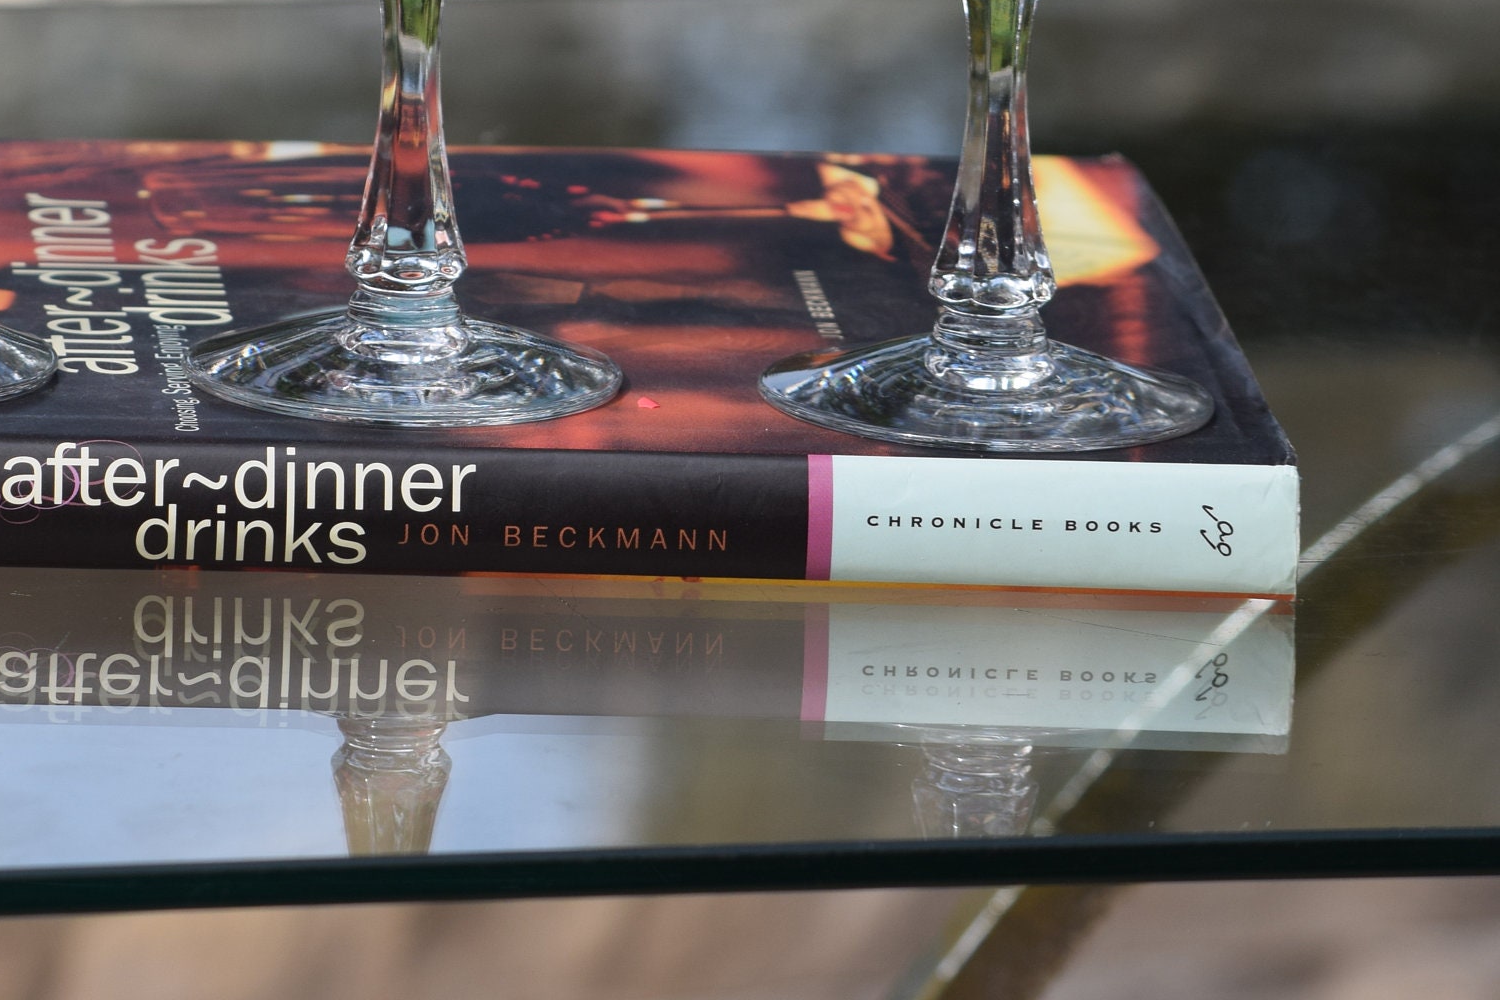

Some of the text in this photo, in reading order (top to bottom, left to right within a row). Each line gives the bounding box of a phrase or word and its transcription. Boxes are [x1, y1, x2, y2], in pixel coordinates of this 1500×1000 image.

[120, 238, 233, 326] drinks
[1, 441, 477, 514] after~dinner
[135, 503, 728, 565] drinks JON BECKMANN
[866, 514, 1162, 534] CHRONICLE BOOKS
